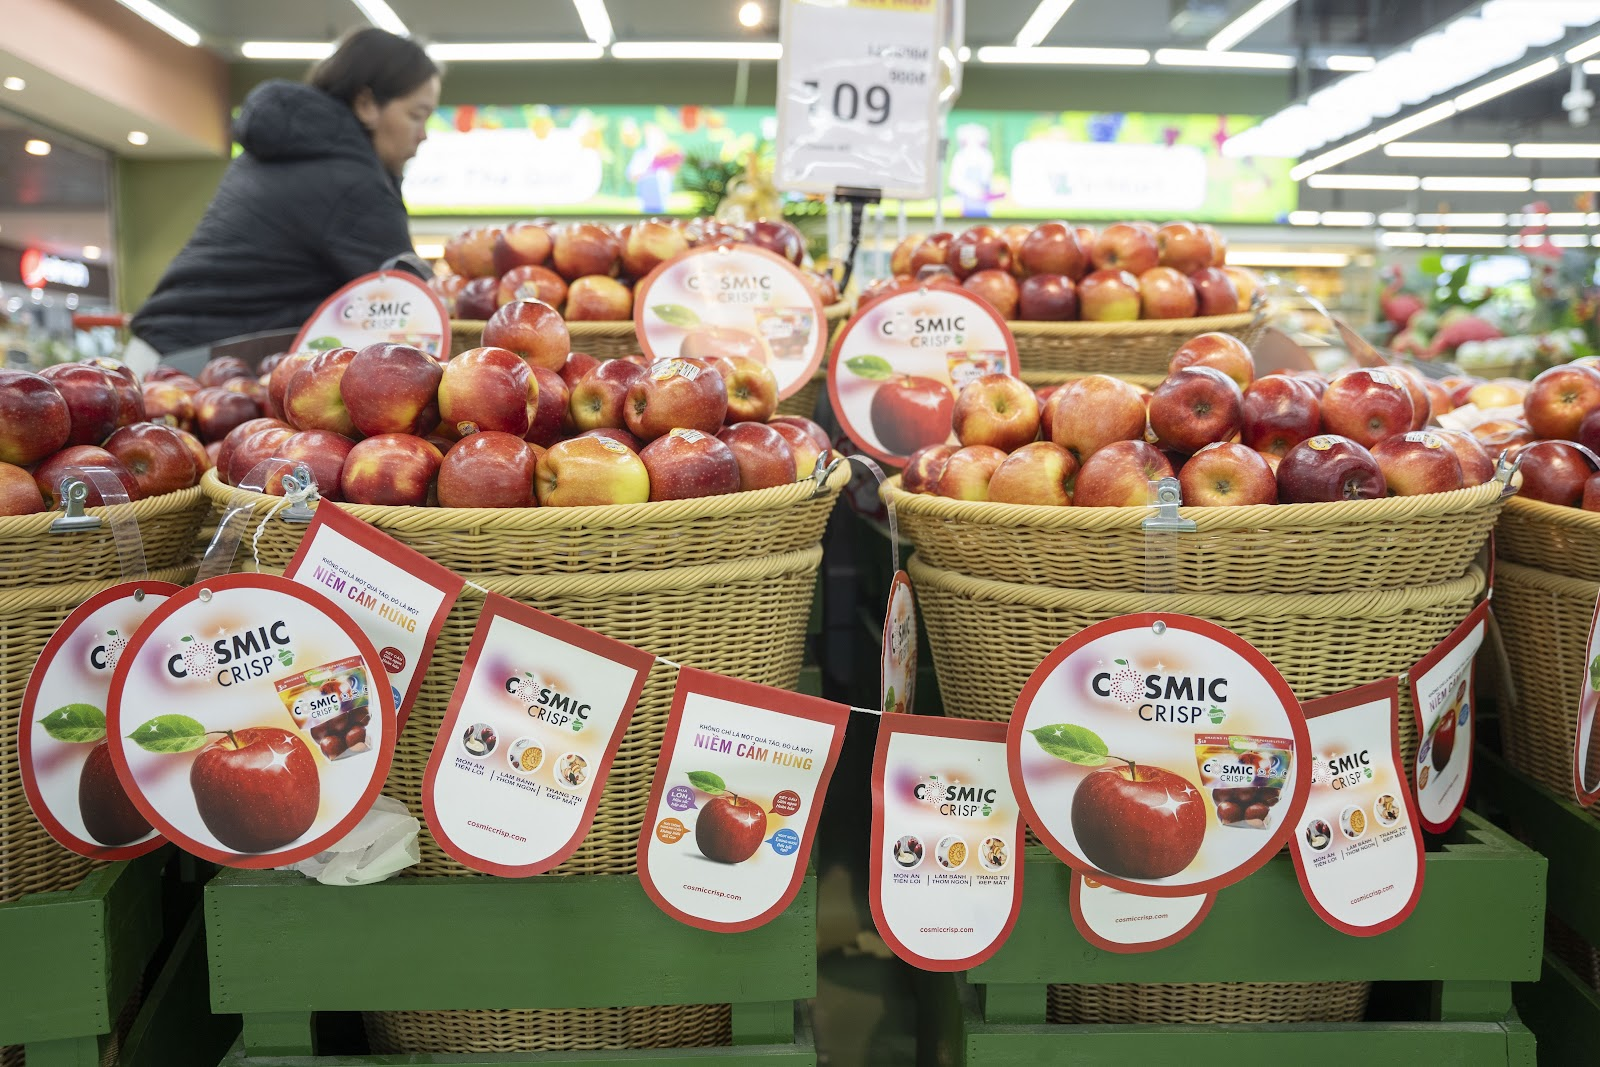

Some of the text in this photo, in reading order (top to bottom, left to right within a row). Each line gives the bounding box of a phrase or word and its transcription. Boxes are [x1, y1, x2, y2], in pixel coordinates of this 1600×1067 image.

[688, 276, 771, 290] CSMIC
[344, 302, 411, 318] CSMIC
[167, 620, 291, 678] COSMIC
[1092, 670, 1228, 703] COSMIC
[505, 677, 591, 720] COSMIC
[1311, 750, 1371, 784] OSMIC
[914, 782, 996, 804] COSMIC
[467, 819, 527, 843] cosmiccrisp.com
[682, 883, 742, 901] cosmiccrisp.com
[1350, 883, 1394, 905] cosmiccrisp.com
[1115, 913, 1168, 923] cosmiccrisp.com
[920, 926, 974, 934] cosmiccrisp.com
